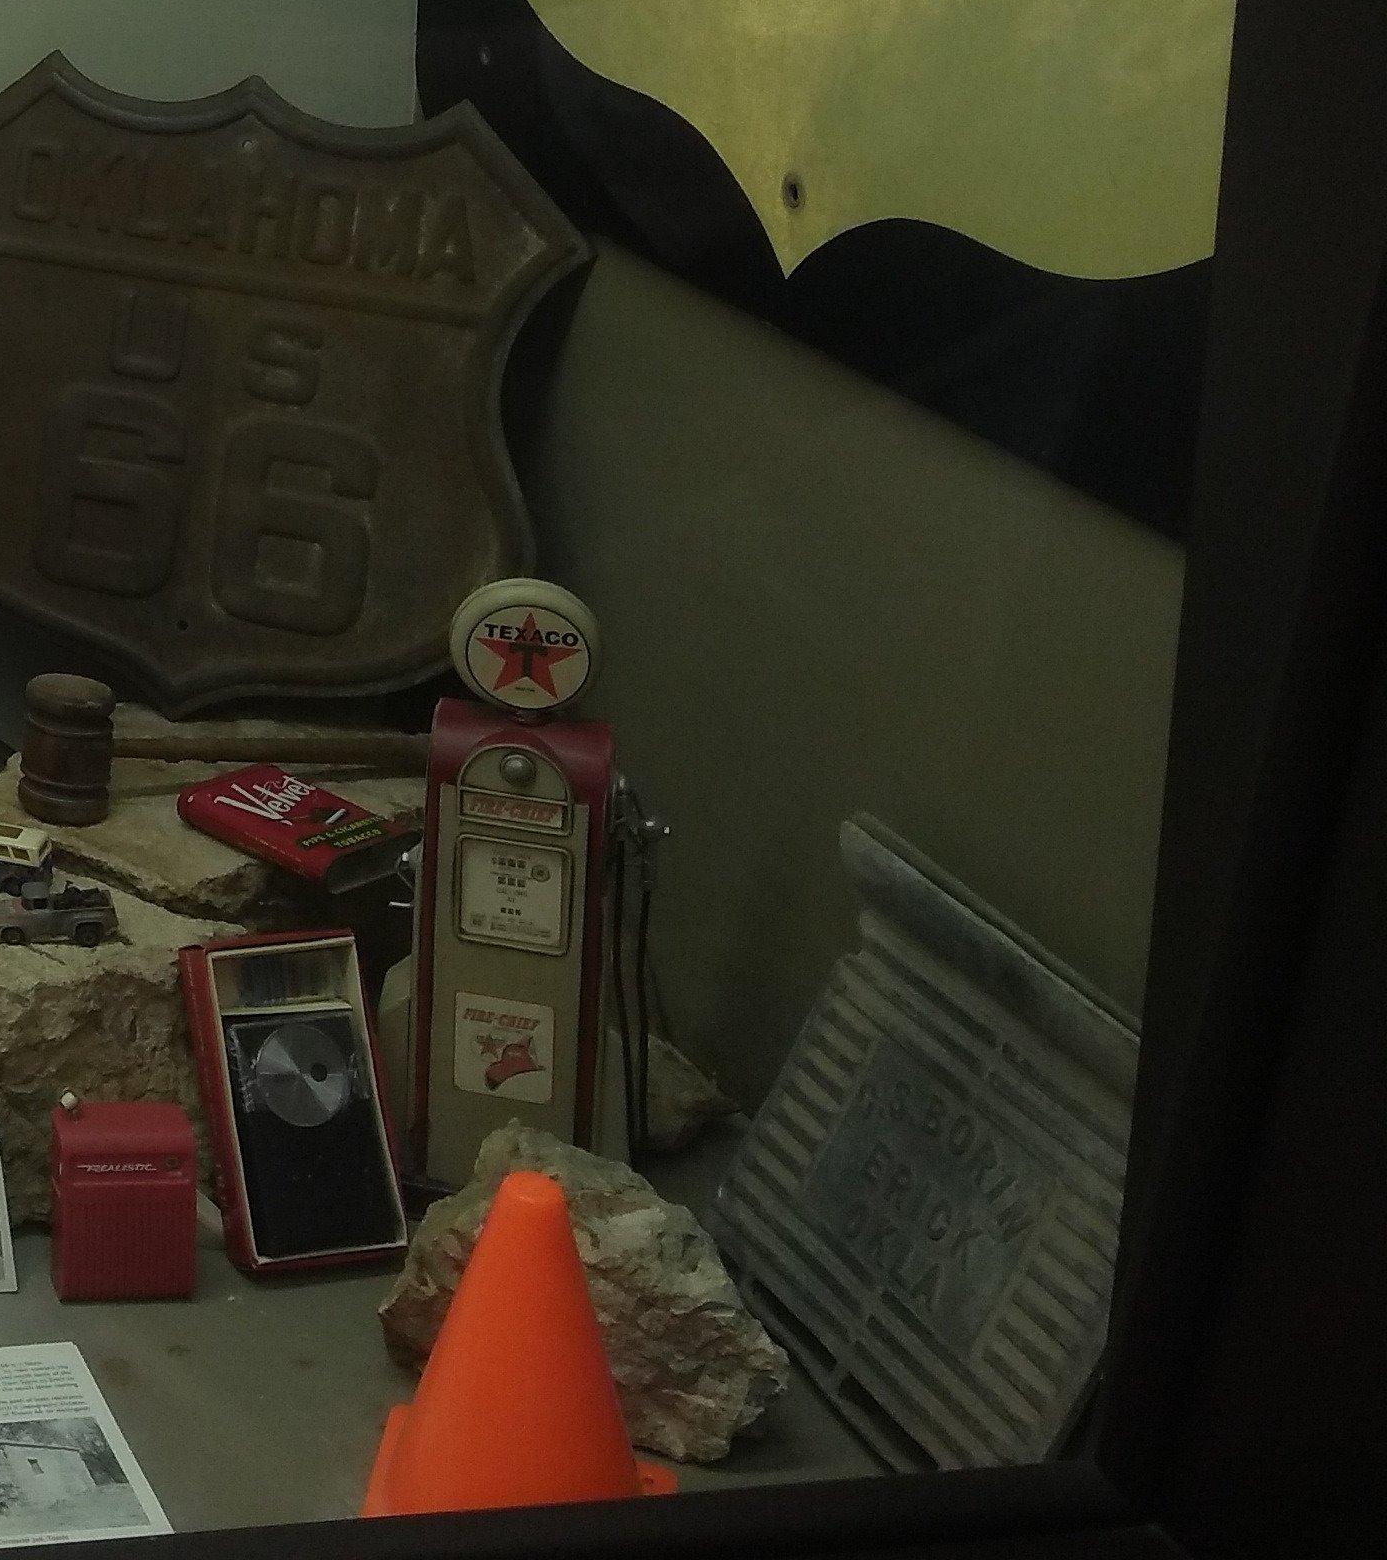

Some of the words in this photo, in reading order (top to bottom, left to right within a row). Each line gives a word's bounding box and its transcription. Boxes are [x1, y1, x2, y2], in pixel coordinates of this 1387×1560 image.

[13, 139, 477, 285] OKLAHOMA
[33, 383, 382, 637] 66
[483, 623, 579, 648] TEXACO
[213, 775, 317, 826] Velvet
